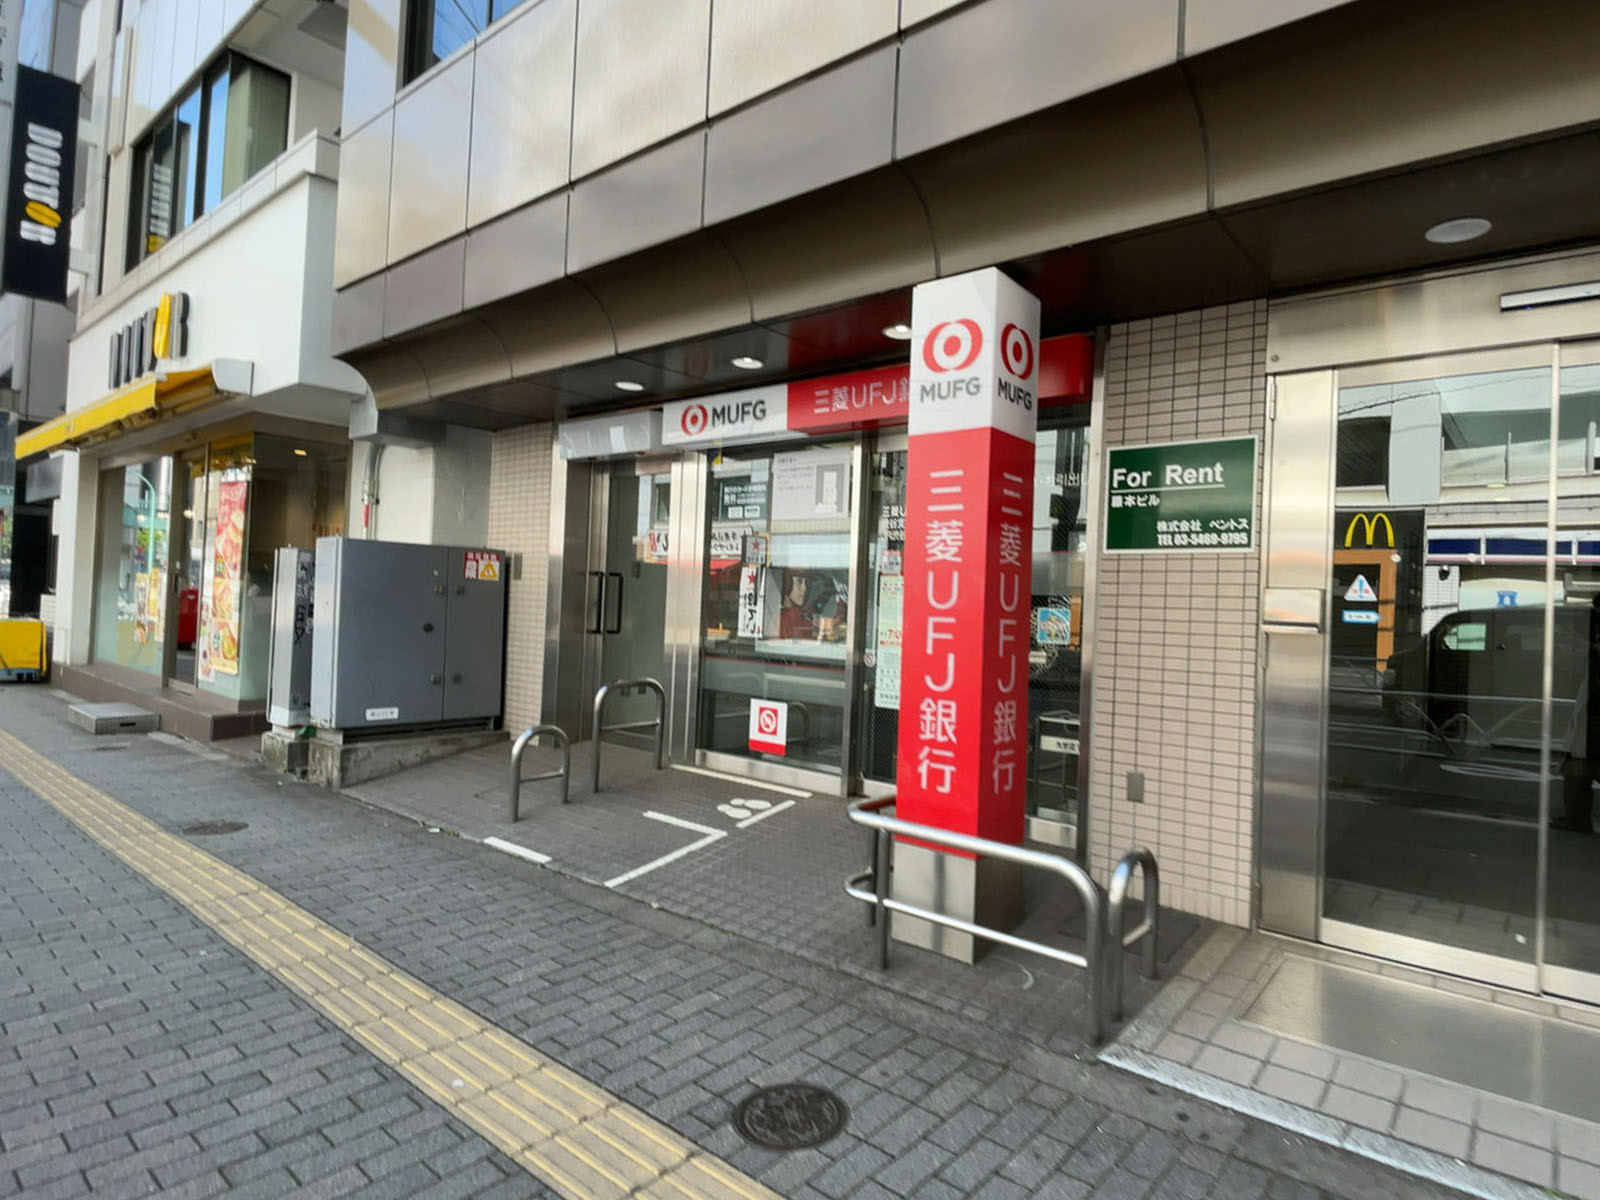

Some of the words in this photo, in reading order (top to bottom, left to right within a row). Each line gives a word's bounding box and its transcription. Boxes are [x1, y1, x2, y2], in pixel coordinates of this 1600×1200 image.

[19, 121, 64, 247] DOUTOR
[920, 376, 981, 404] MUFG
[997, 377, 1033, 411] MUFG
[711, 400, 767, 428] MUFG
[1111, 467, 1153, 489] For
[1165, 461, 1224, 486] Rent
[1156, 519, 1203, 533] 株式会社
[917, 469, 964, 794] 三菱UFJ銀行
[992, 471, 1024, 795] 三菱UFJ銀行
